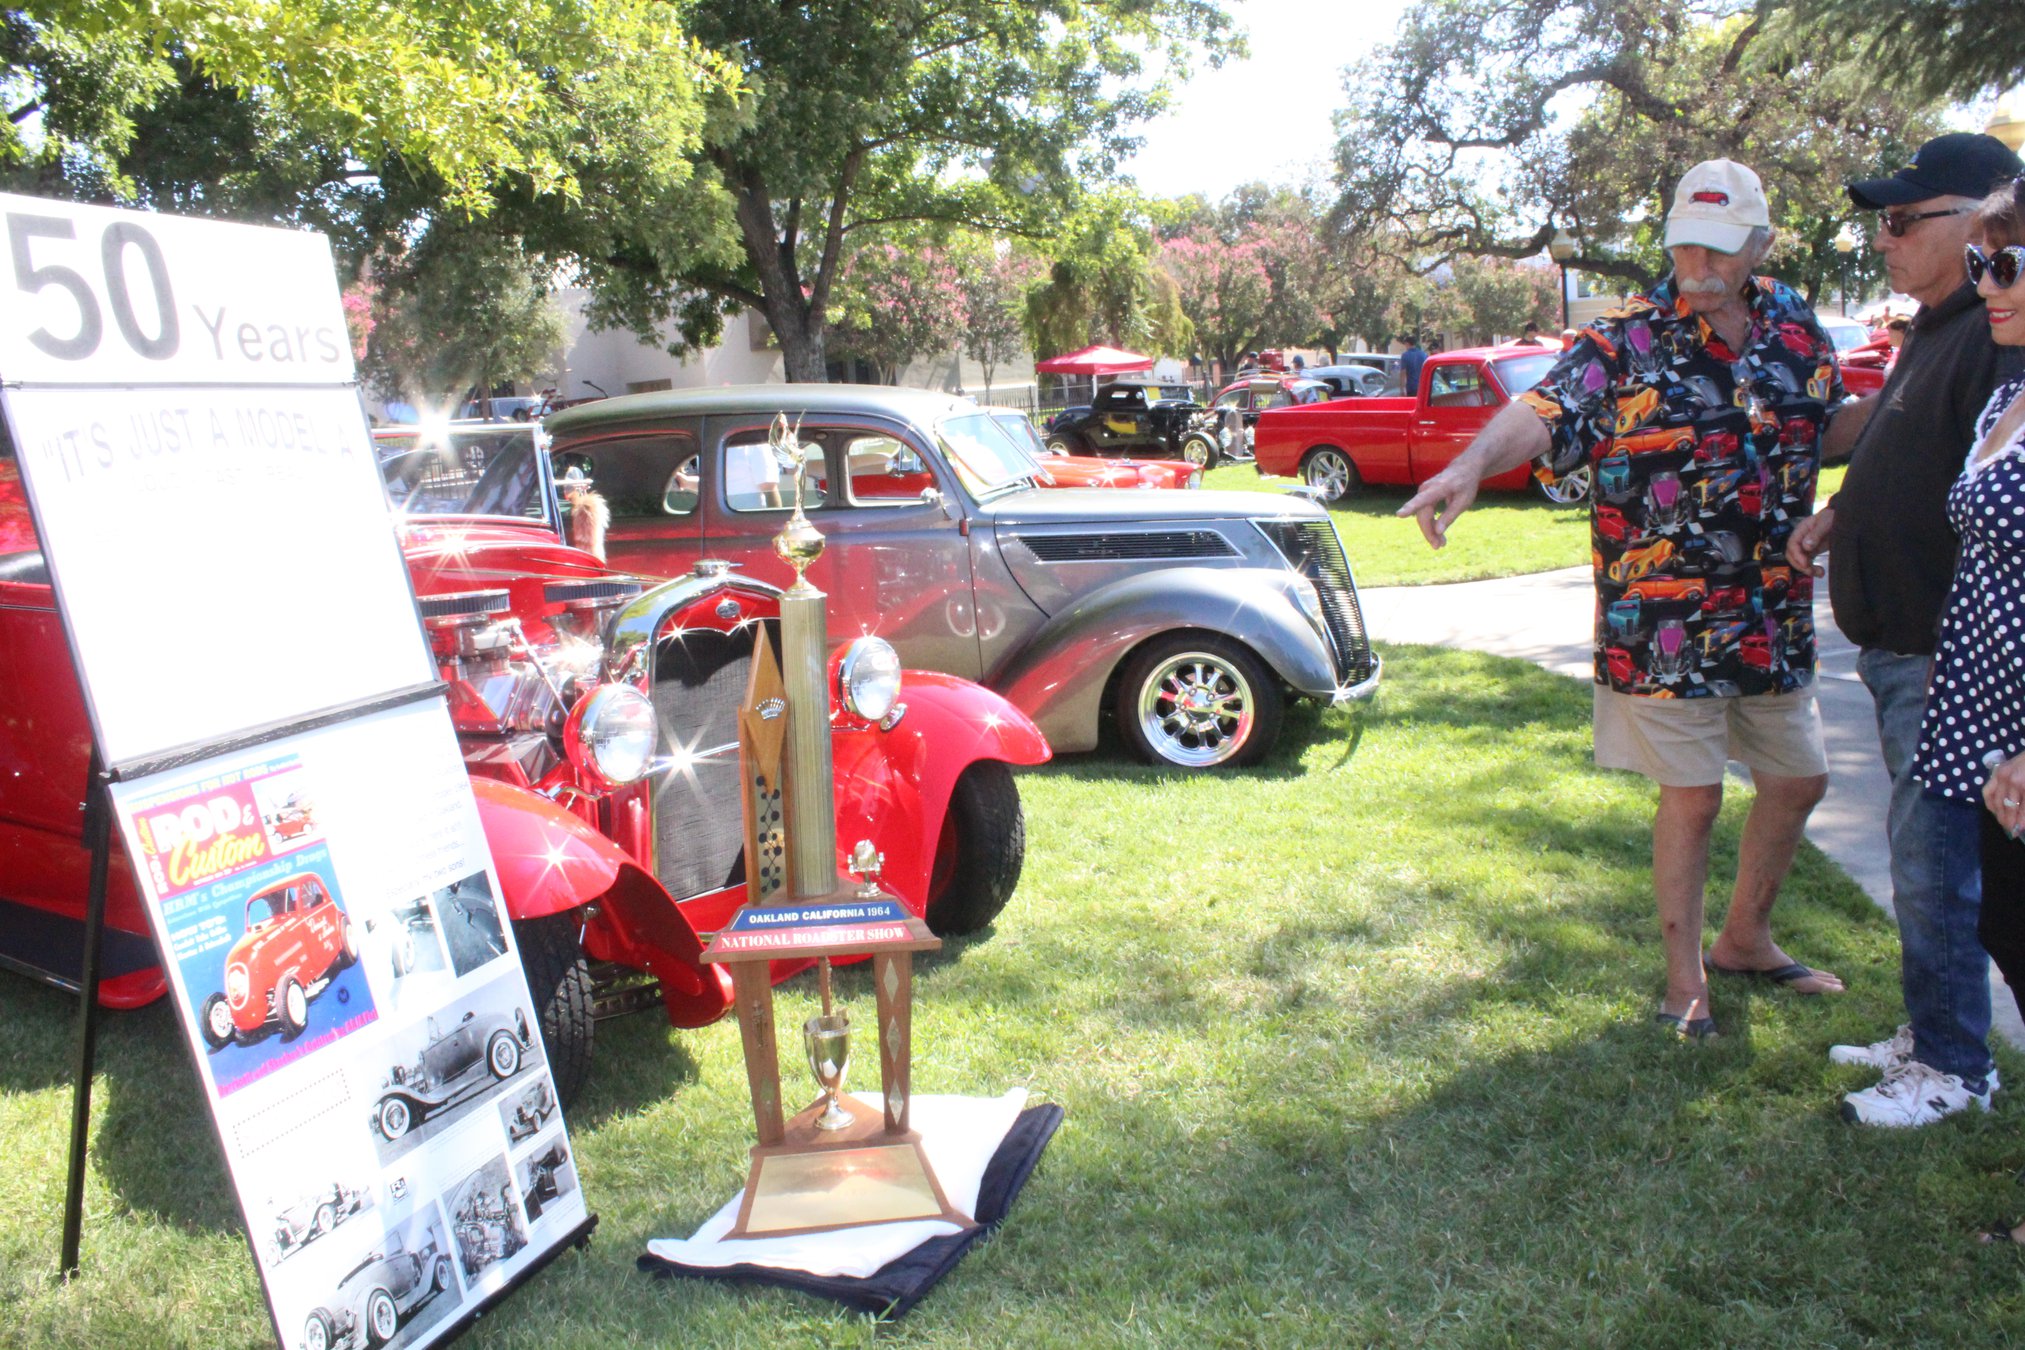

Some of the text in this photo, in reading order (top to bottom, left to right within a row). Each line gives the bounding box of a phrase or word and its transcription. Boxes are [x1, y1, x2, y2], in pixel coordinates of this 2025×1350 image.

[6, 212, 341, 364] 50 Years
[129, 408, 195, 461] JUST
[209, 406, 230, 451] A
[235, 408, 328, 457] MODEL
[150, 796, 239, 853] ROD
[169, 833, 264, 886] Custom
[721, 926, 906, 950] NATIONAL ROADSTER SHOW
[749, 907, 890, 925] OAKLAND CALIFORNIA 1964
